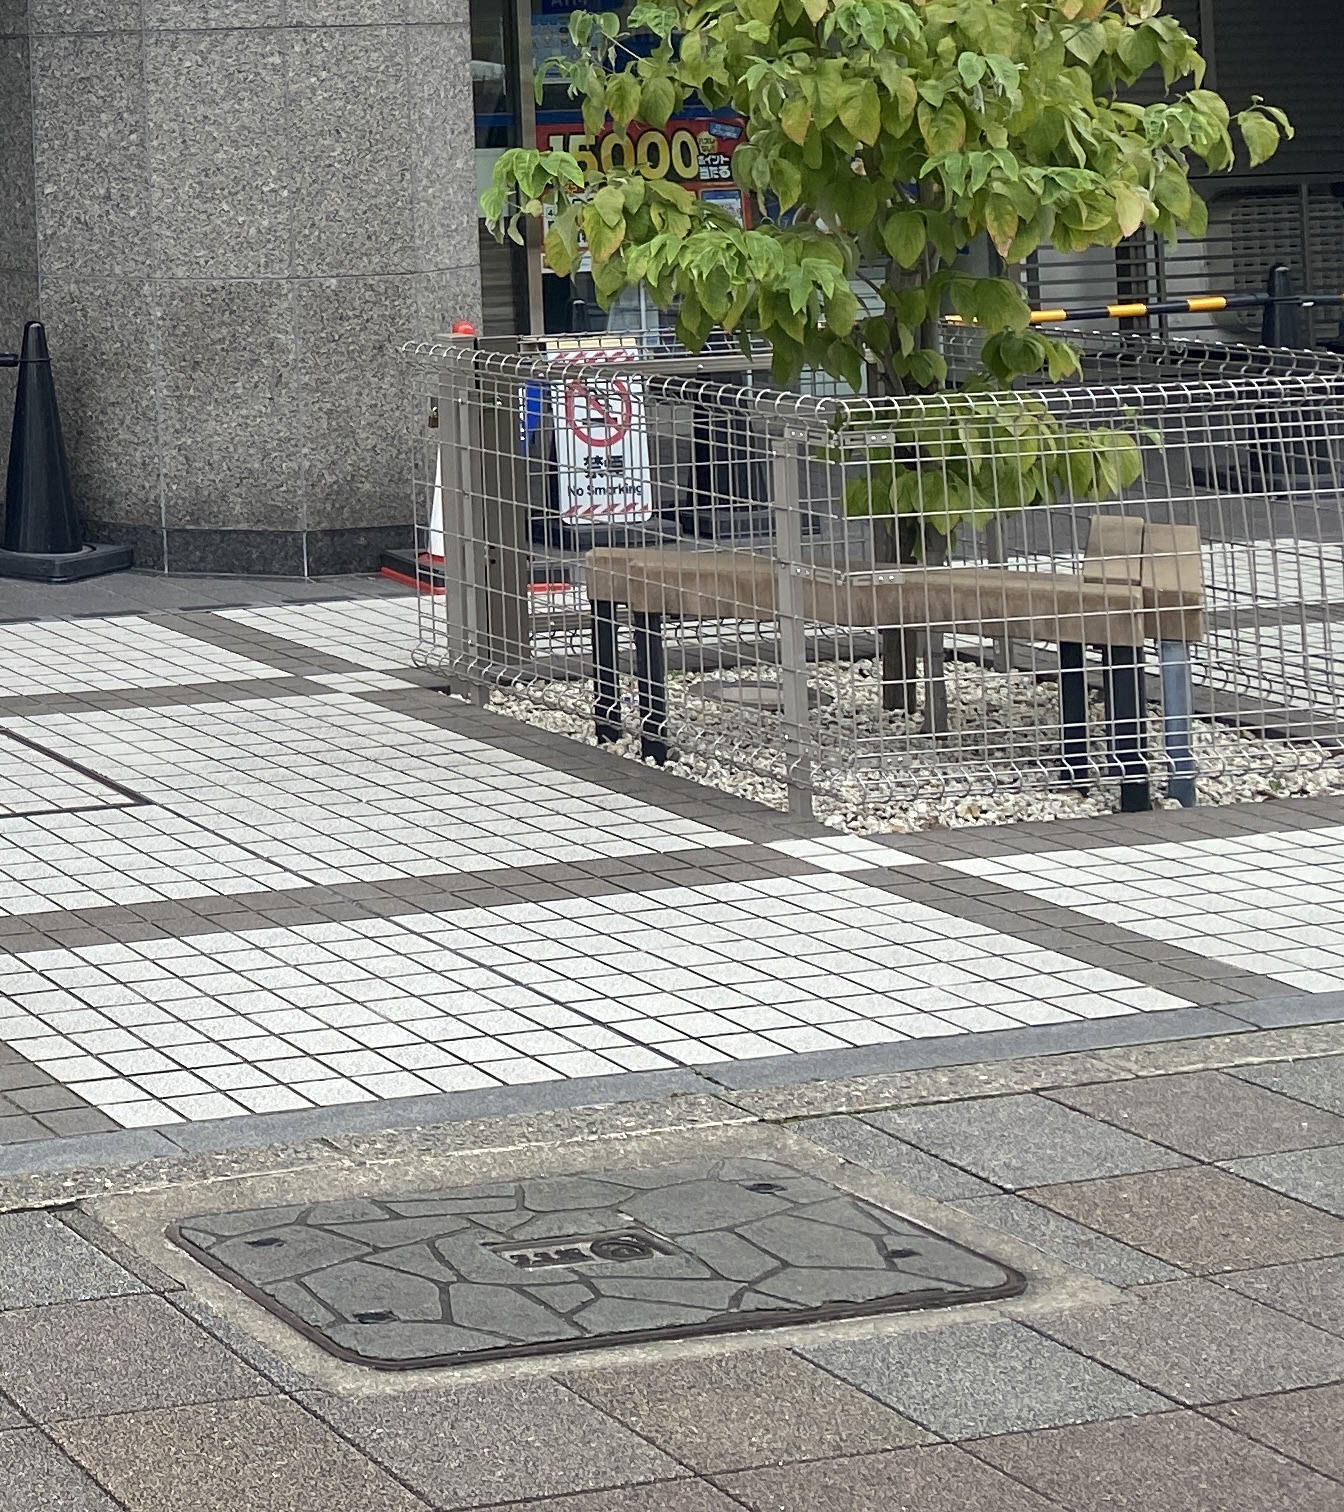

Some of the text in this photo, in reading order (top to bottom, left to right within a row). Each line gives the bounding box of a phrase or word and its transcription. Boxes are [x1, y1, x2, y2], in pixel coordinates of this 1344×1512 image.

[698, 155, 730, 165] ポイント
[699, 165, 731, 180] 当たる
[567, 485, 584, 496] No
